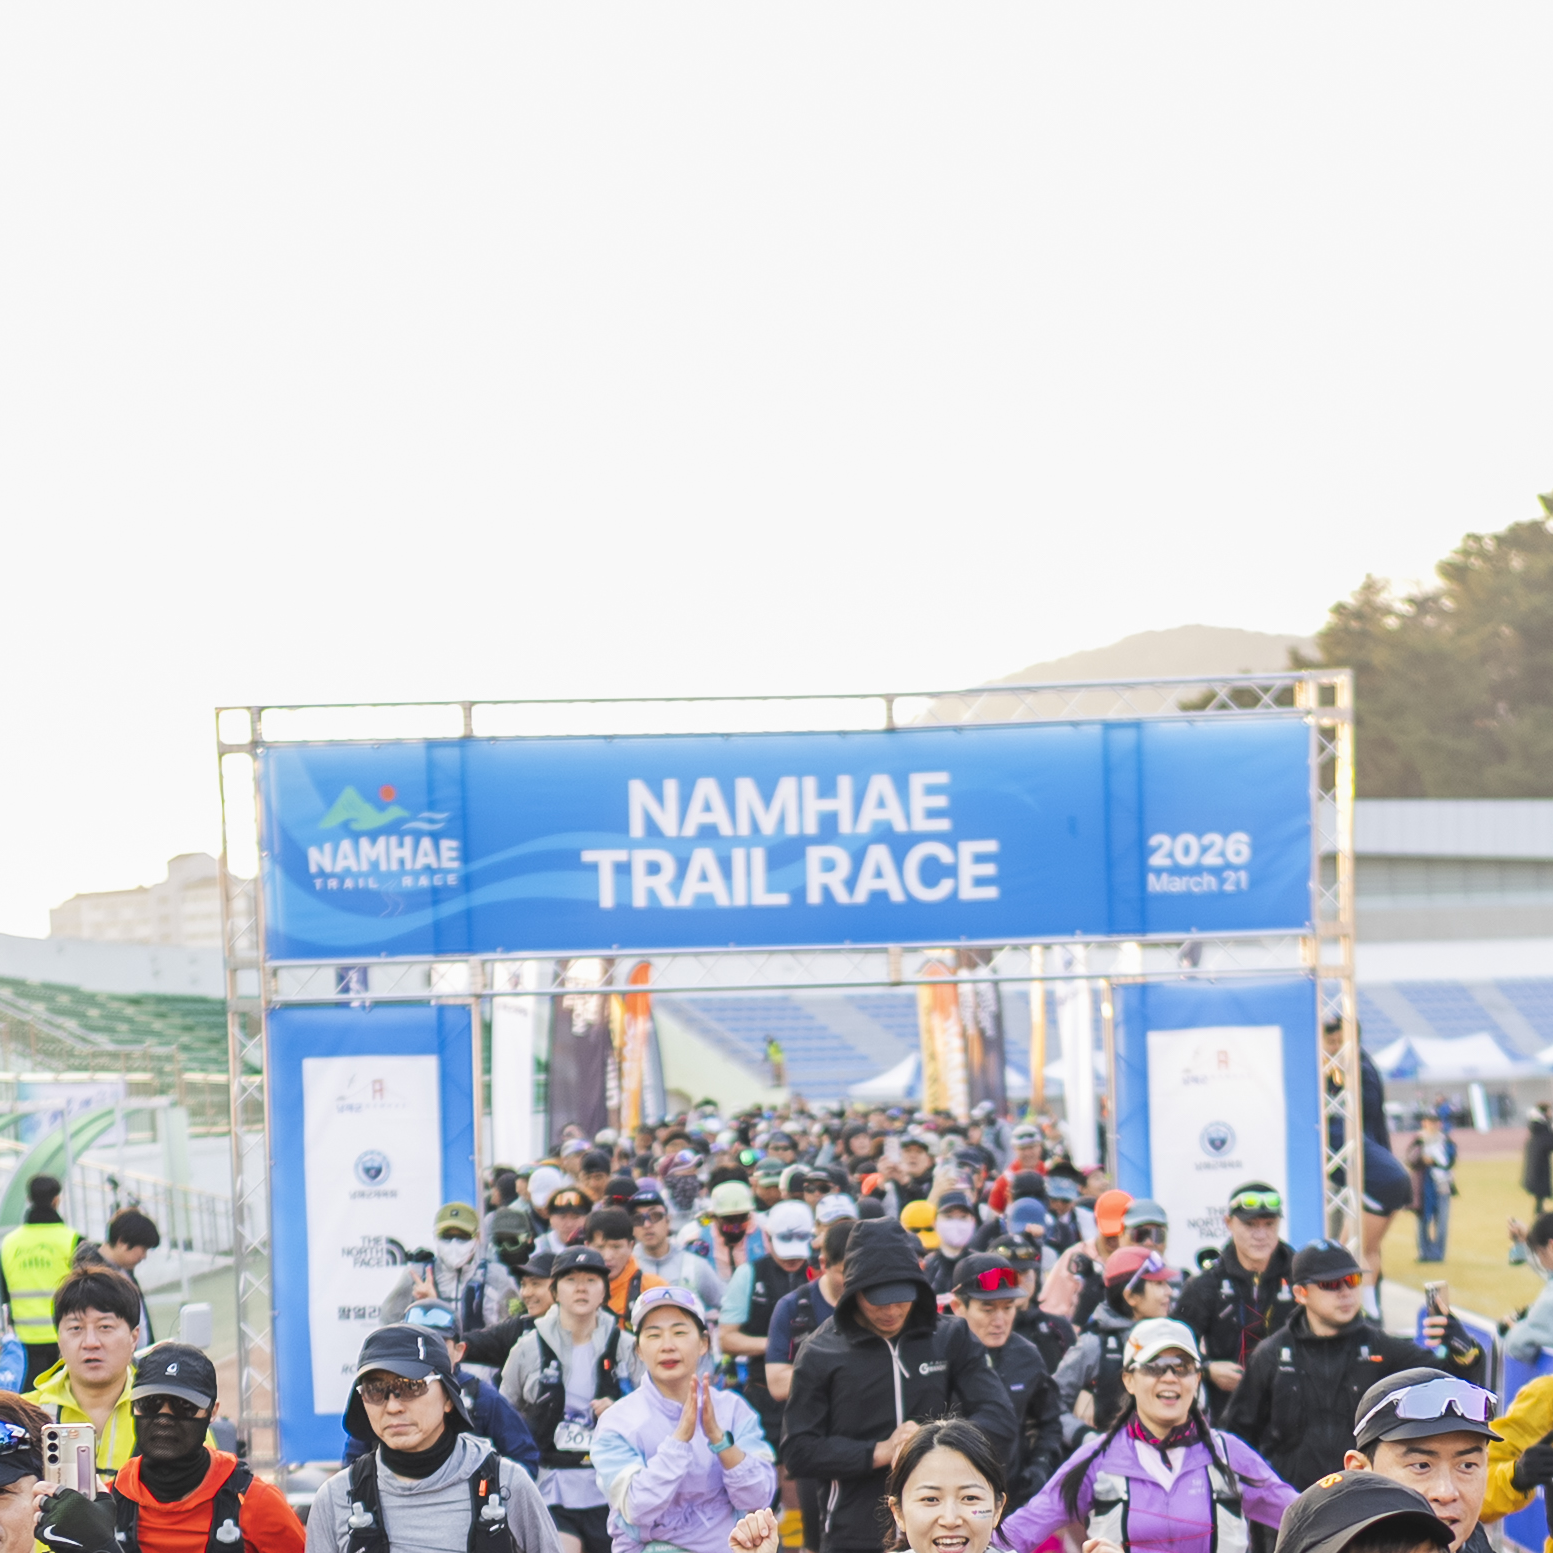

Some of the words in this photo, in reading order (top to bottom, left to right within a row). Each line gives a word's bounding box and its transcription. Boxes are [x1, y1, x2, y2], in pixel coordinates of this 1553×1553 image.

[626, 770, 952, 838] NAMHAE
[307, 835, 461, 873] NAMHAE
[1147, 831, 1251, 868] 2026
[313, 877, 379, 890] TRAIL
[402, 873, 459, 887] RACE
[581, 845, 790, 911] TRAIL
[808, 839, 1001, 905] RACE
[1146, 870, 1218, 894] March
[1224, 870, 1247, 893] 21
[1187, 1218, 1227, 1229] NORT
[341, 1246, 383, 1257] NORTH
[360, 1236, 383, 1247] THE
[353, 1257, 384, 1267] FACE
